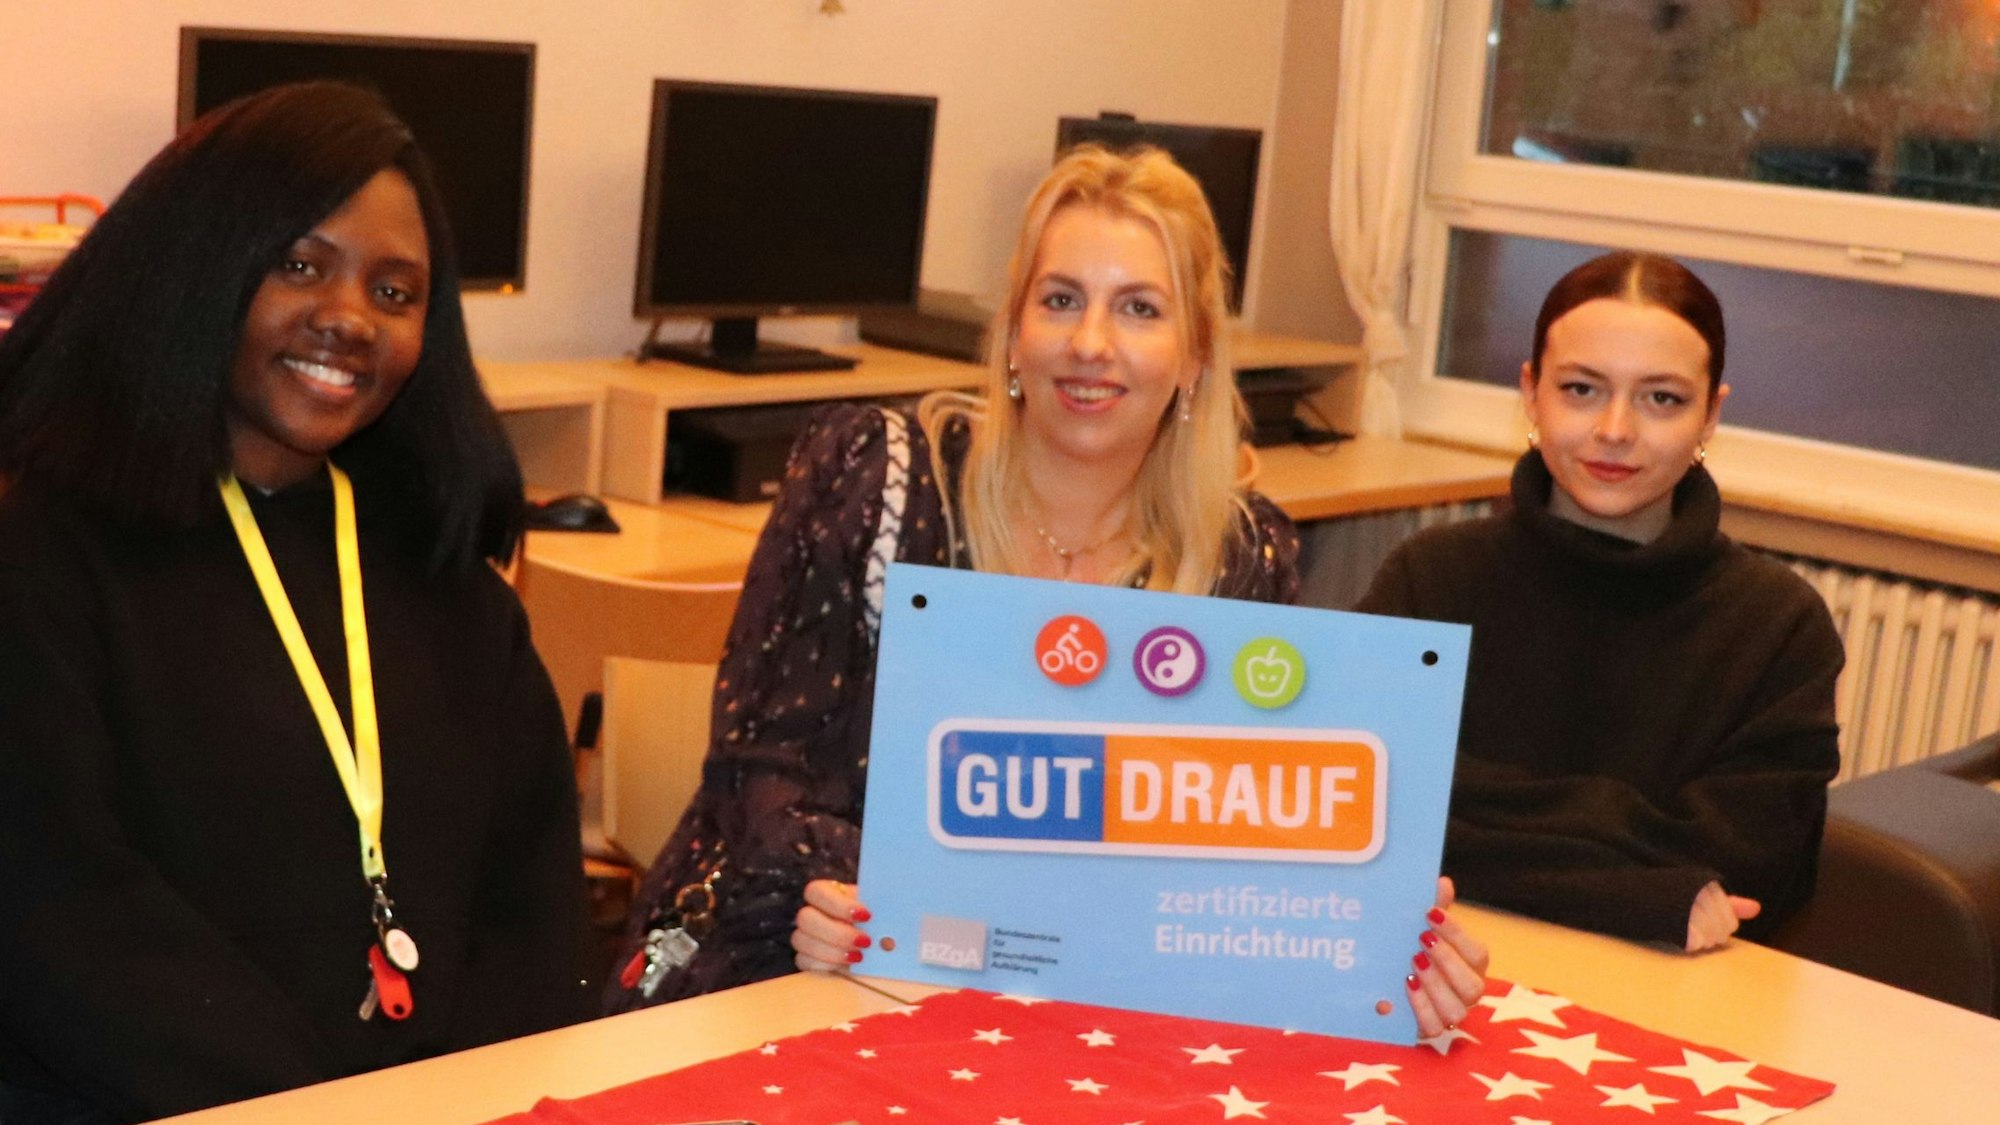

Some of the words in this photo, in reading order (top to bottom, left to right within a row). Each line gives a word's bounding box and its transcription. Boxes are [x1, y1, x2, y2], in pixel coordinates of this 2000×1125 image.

[955, 753, 1093, 820] GUT
[1120, 759, 1358, 829] DRAUF
[1156, 884, 1362, 921] zertifizierte
[921, 942, 980, 969] BZgA
[1155, 924, 1357, 970] Einrichtung
